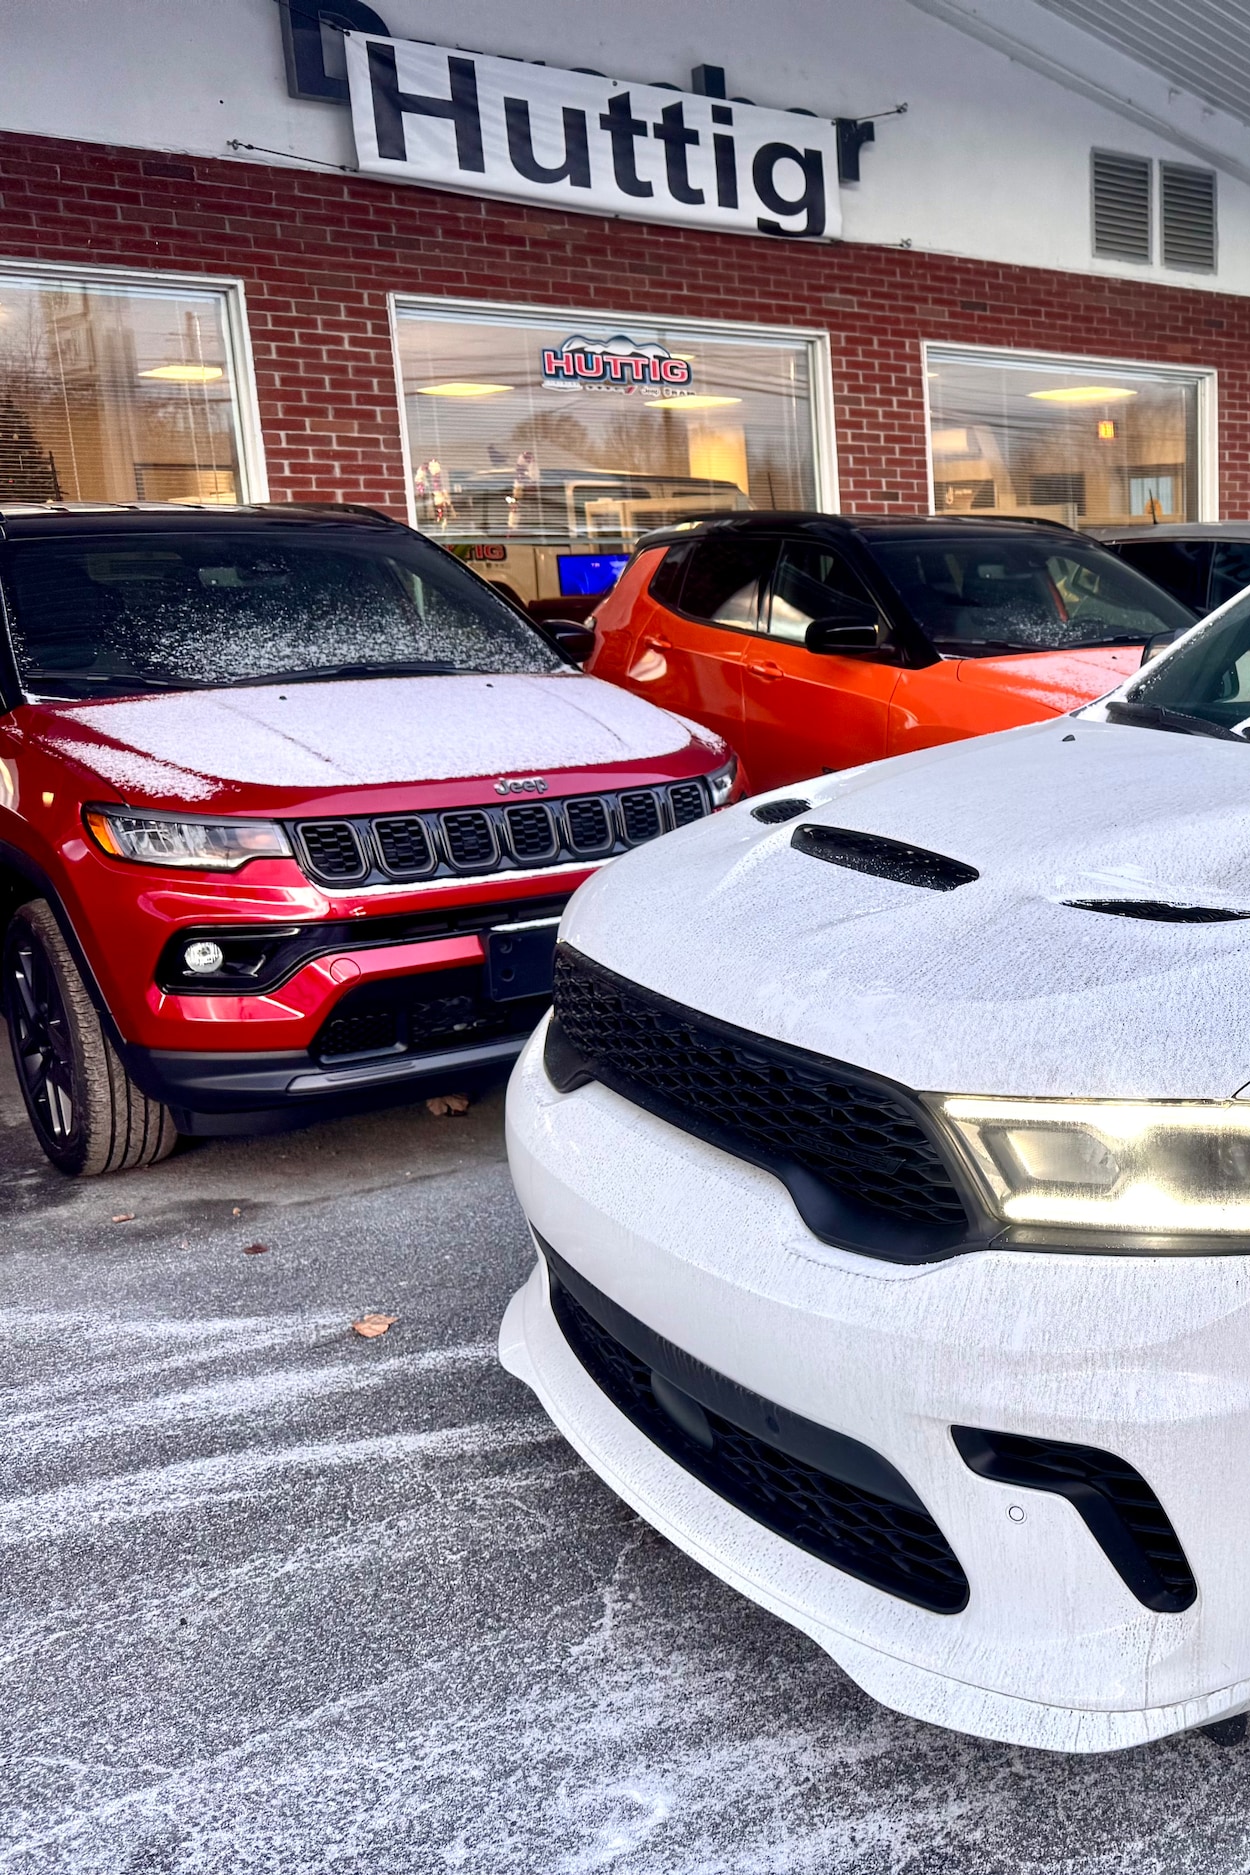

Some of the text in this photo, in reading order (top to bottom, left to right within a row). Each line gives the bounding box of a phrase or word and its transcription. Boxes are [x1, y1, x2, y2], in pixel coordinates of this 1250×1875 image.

[365, 40, 827, 238] Huttig
[543, 350, 690, 384] HUTTIG
[494, 777, 548, 796] Jeep
